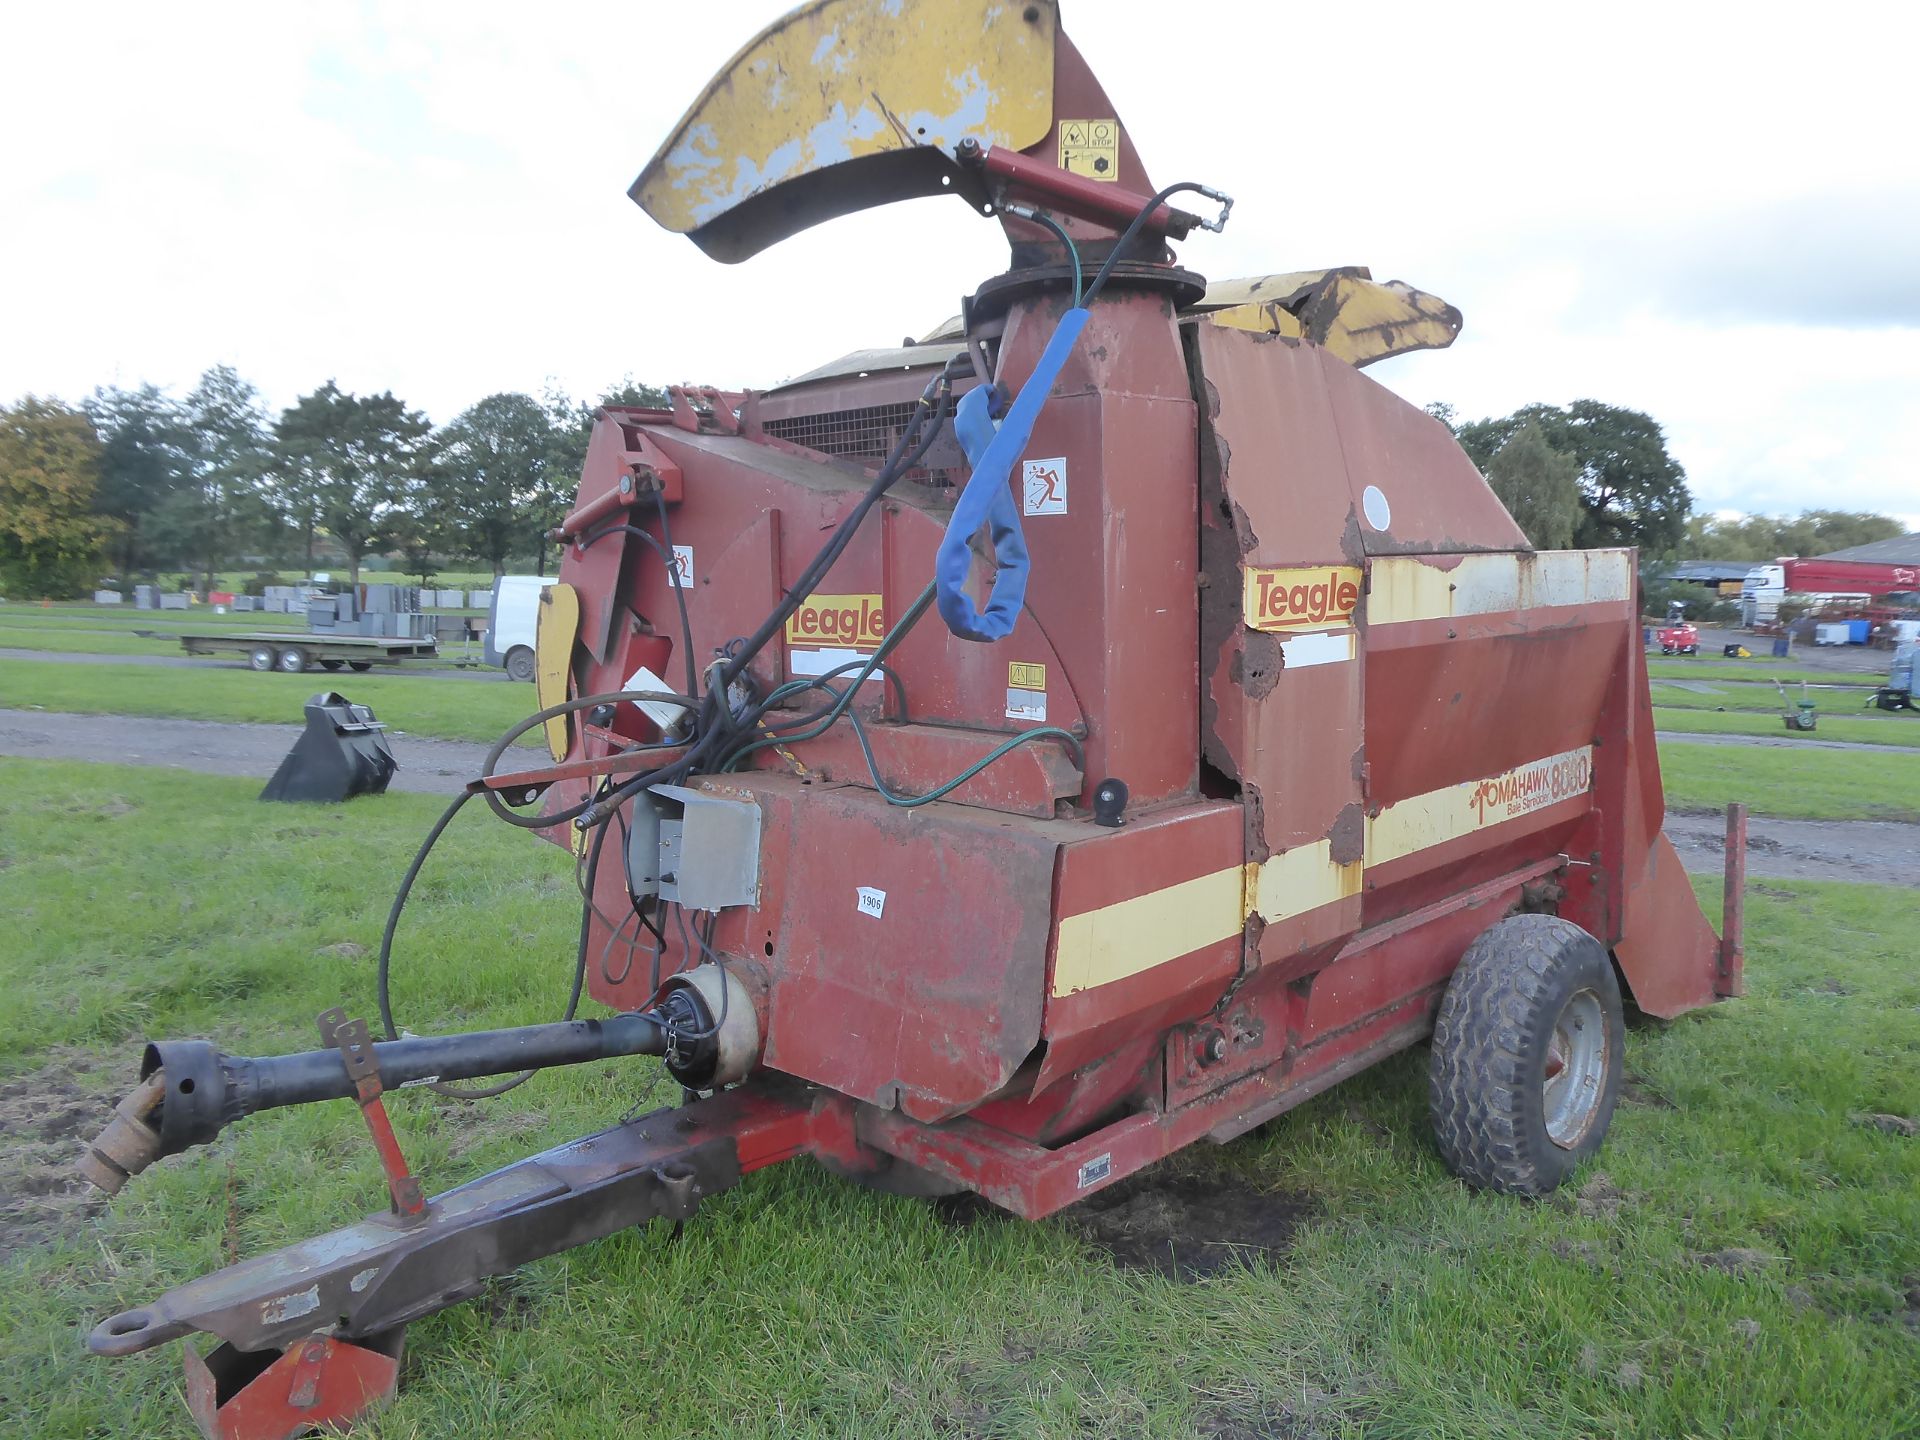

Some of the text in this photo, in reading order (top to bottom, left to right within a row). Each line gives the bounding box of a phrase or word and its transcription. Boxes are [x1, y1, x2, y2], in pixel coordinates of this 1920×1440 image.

[1257, 572, 1358, 622] Teagle
[1507, 793, 1550, 816] Bale Shredder
[863, 895, 880, 909] 1906
